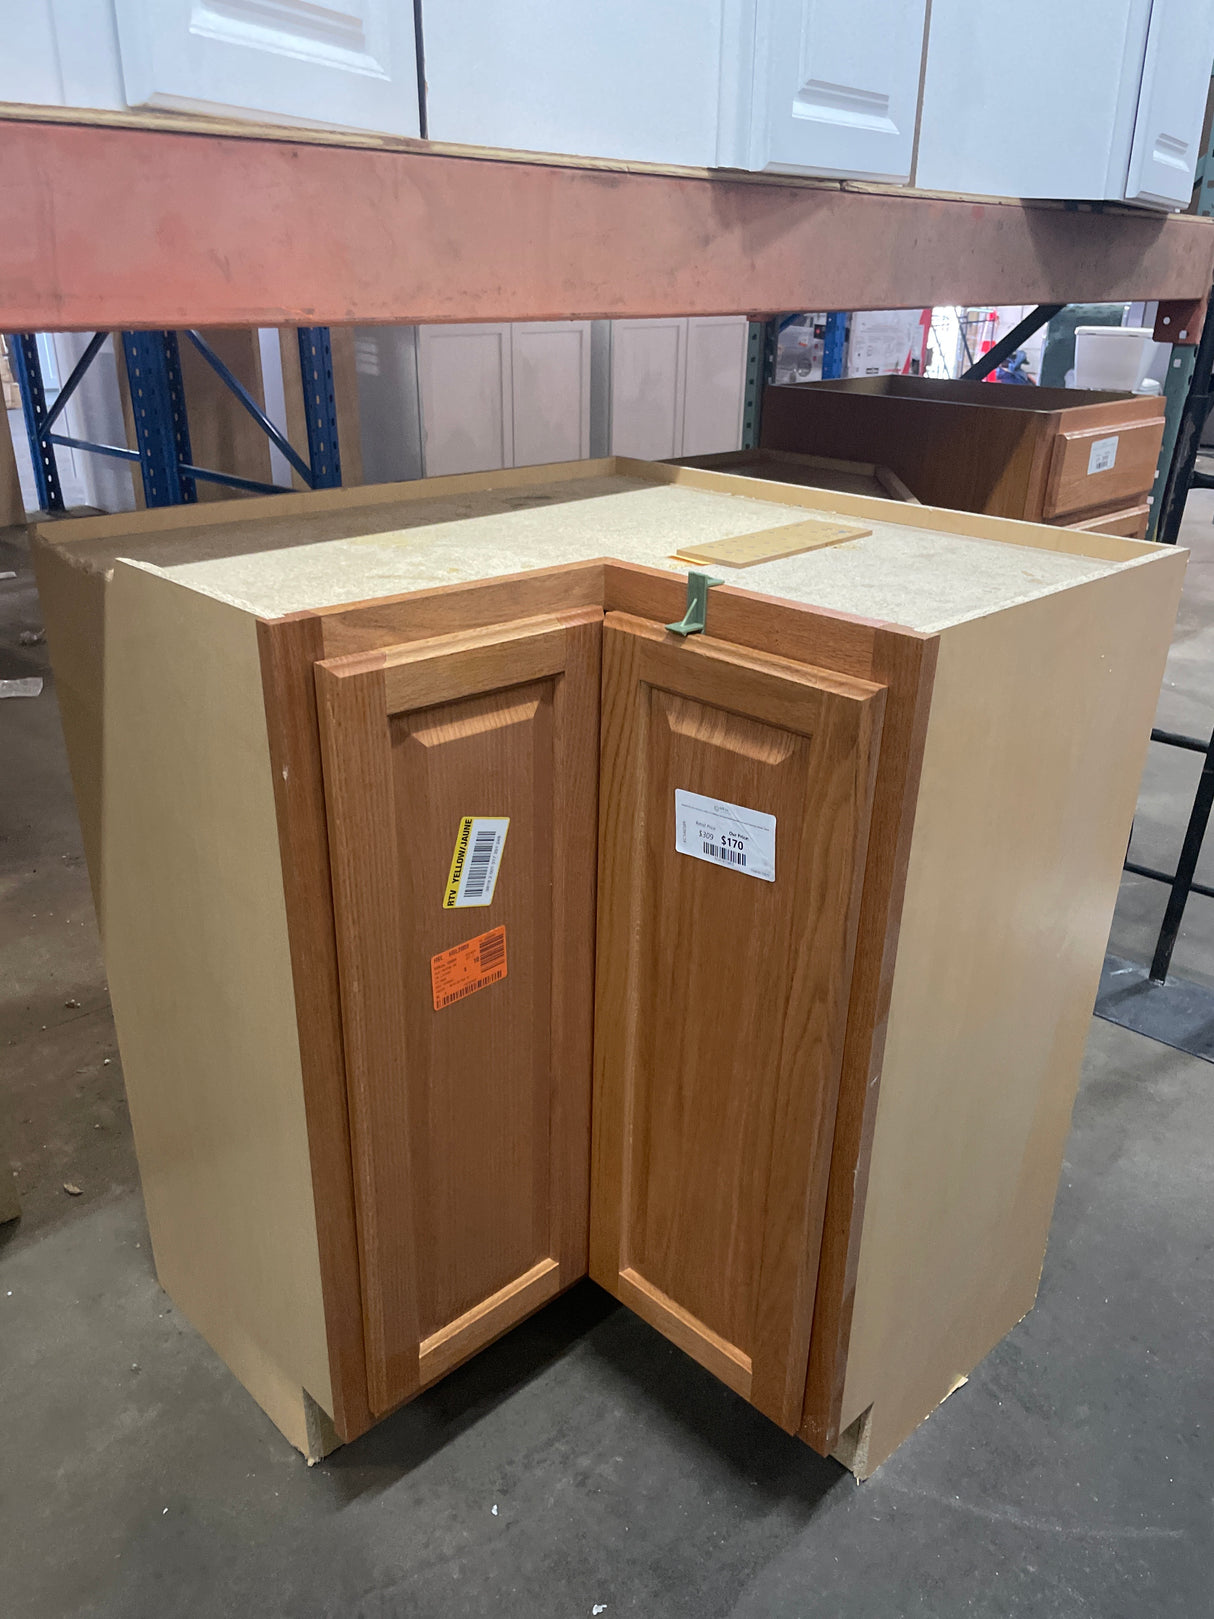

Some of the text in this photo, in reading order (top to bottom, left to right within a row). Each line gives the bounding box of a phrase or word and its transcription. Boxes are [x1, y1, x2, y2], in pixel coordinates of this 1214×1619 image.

[698, 830, 714, 841] $309
[721, 835, 744, 851] $170
[447, 818, 473, 907] RTV YELLOW/JAUNE
